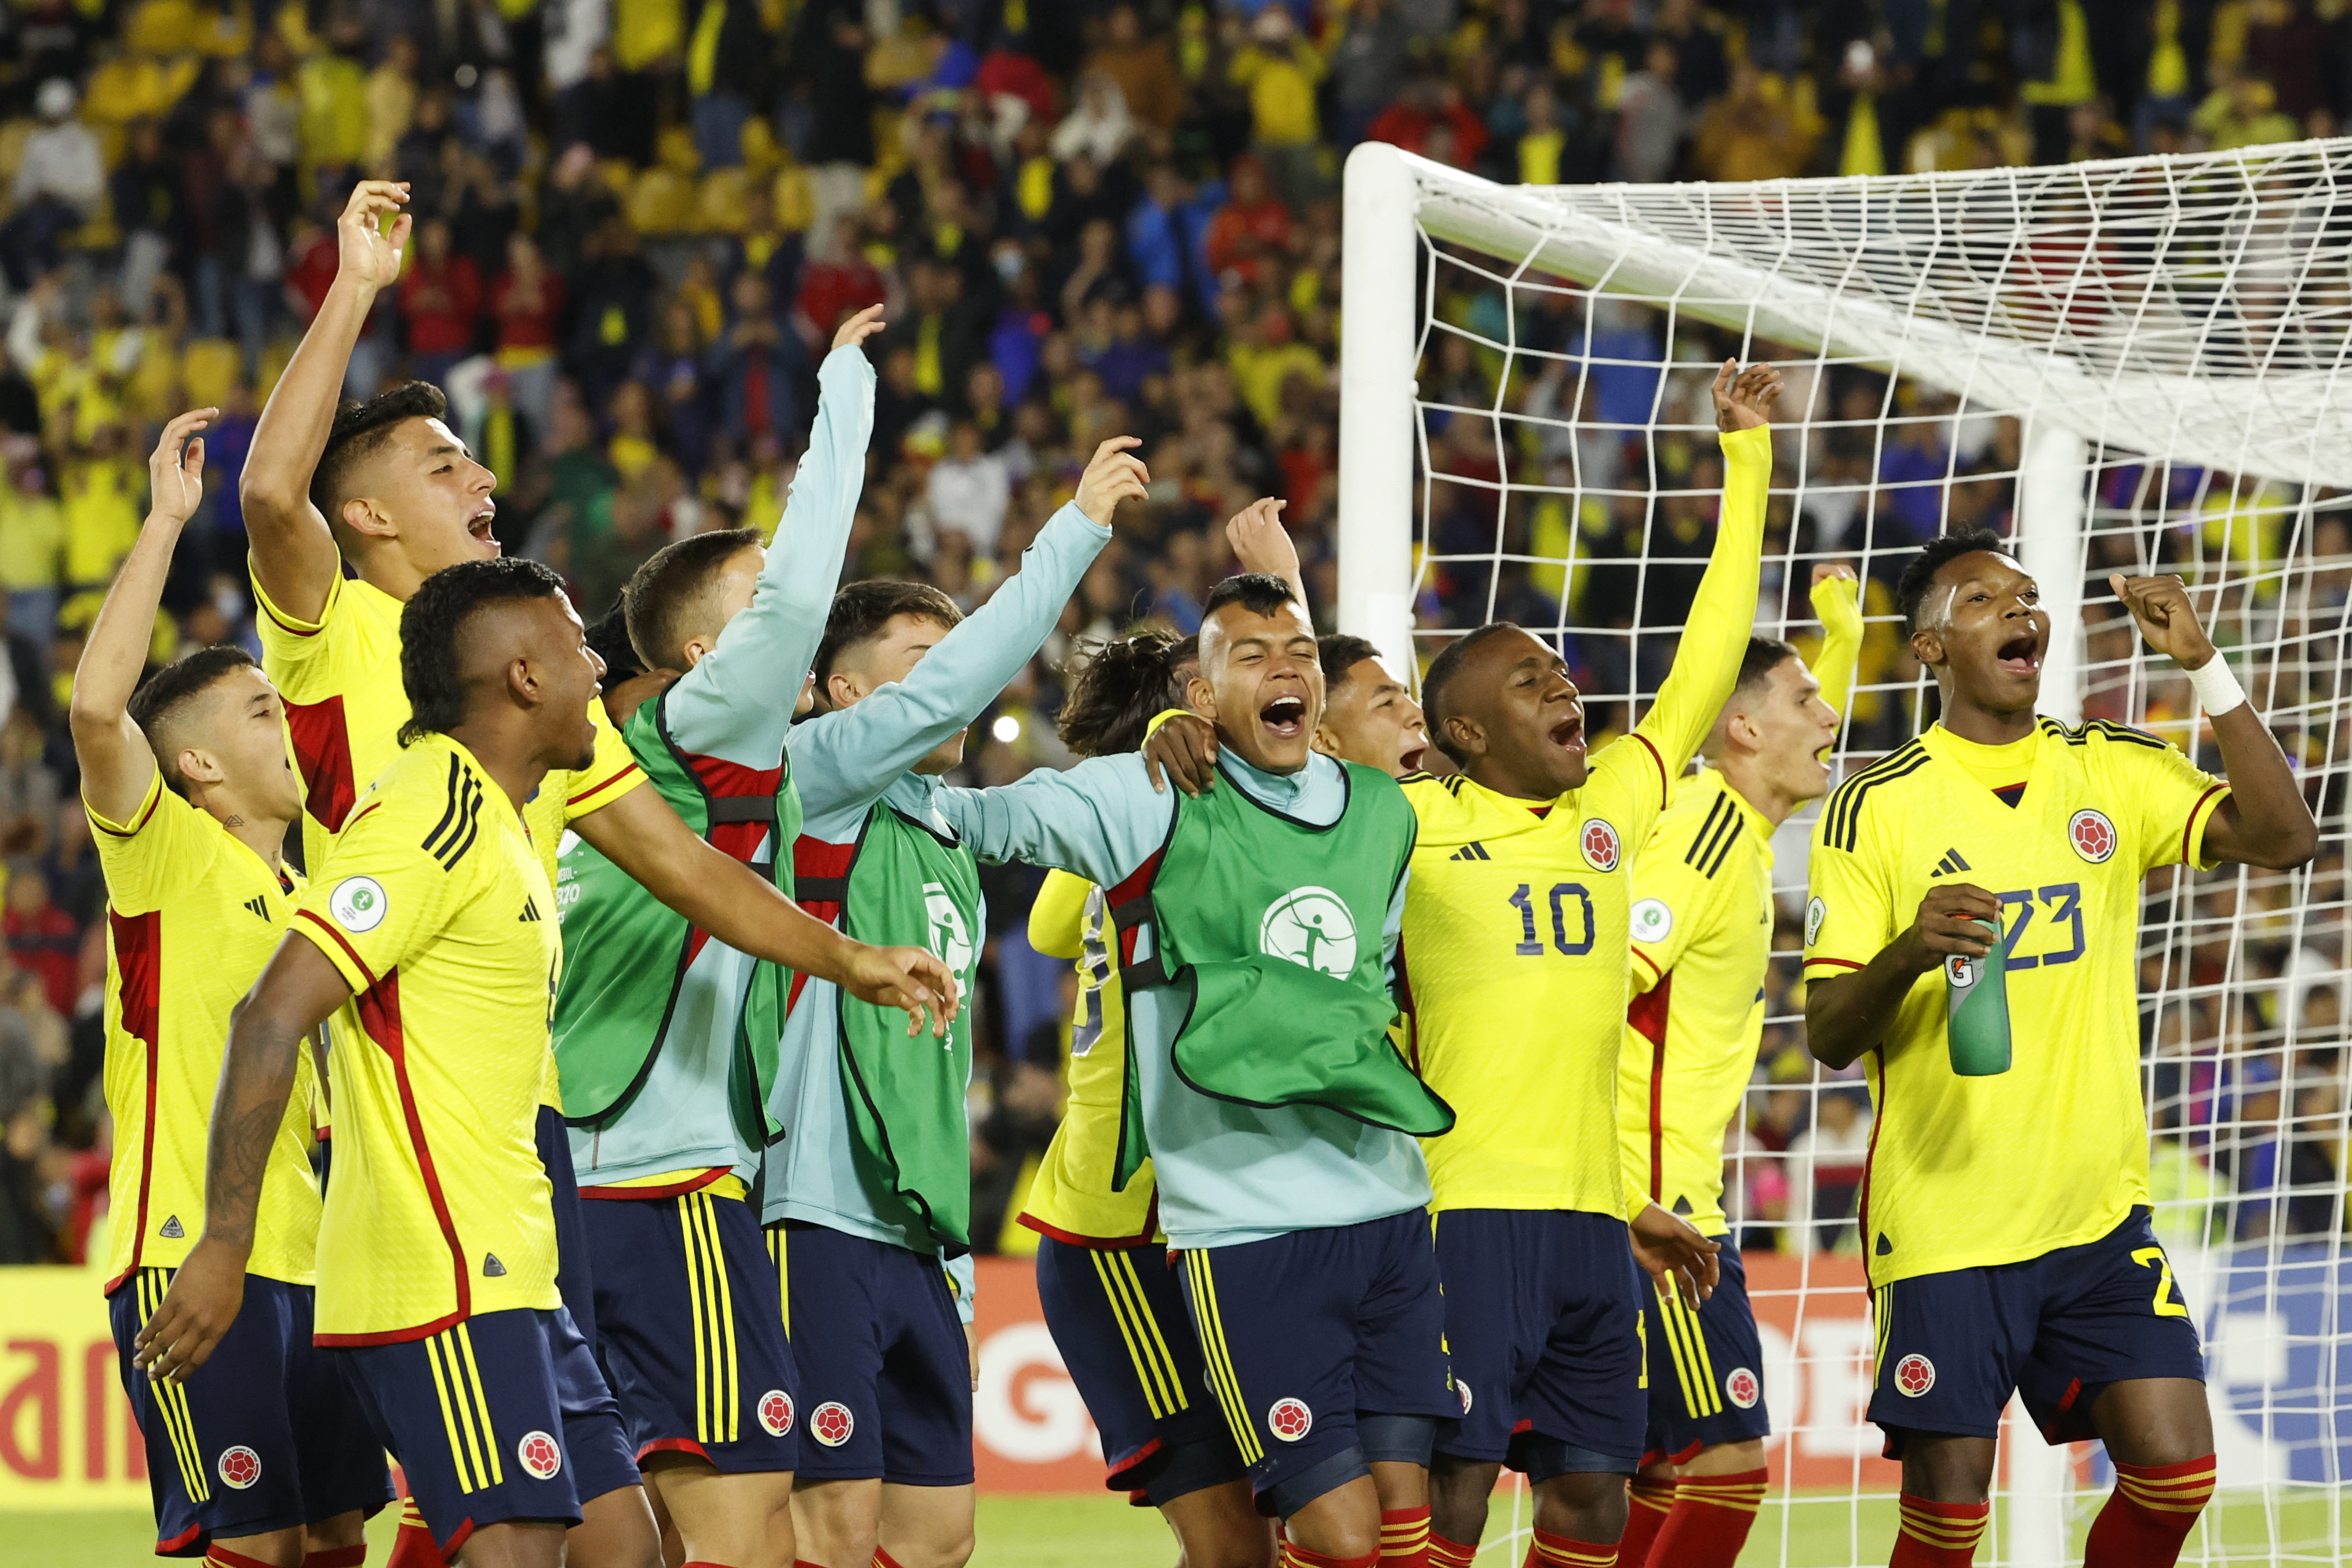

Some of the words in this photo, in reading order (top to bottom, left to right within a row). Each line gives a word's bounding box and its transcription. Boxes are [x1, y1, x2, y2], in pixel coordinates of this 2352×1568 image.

[1508, 883, 1596, 955] 10
[1994, 883, 2085, 971] 23
[1945, 954, 1974, 988] G
[2131, 1247, 2189, 1318] 2
[972, 1321, 1105, 1463] G
